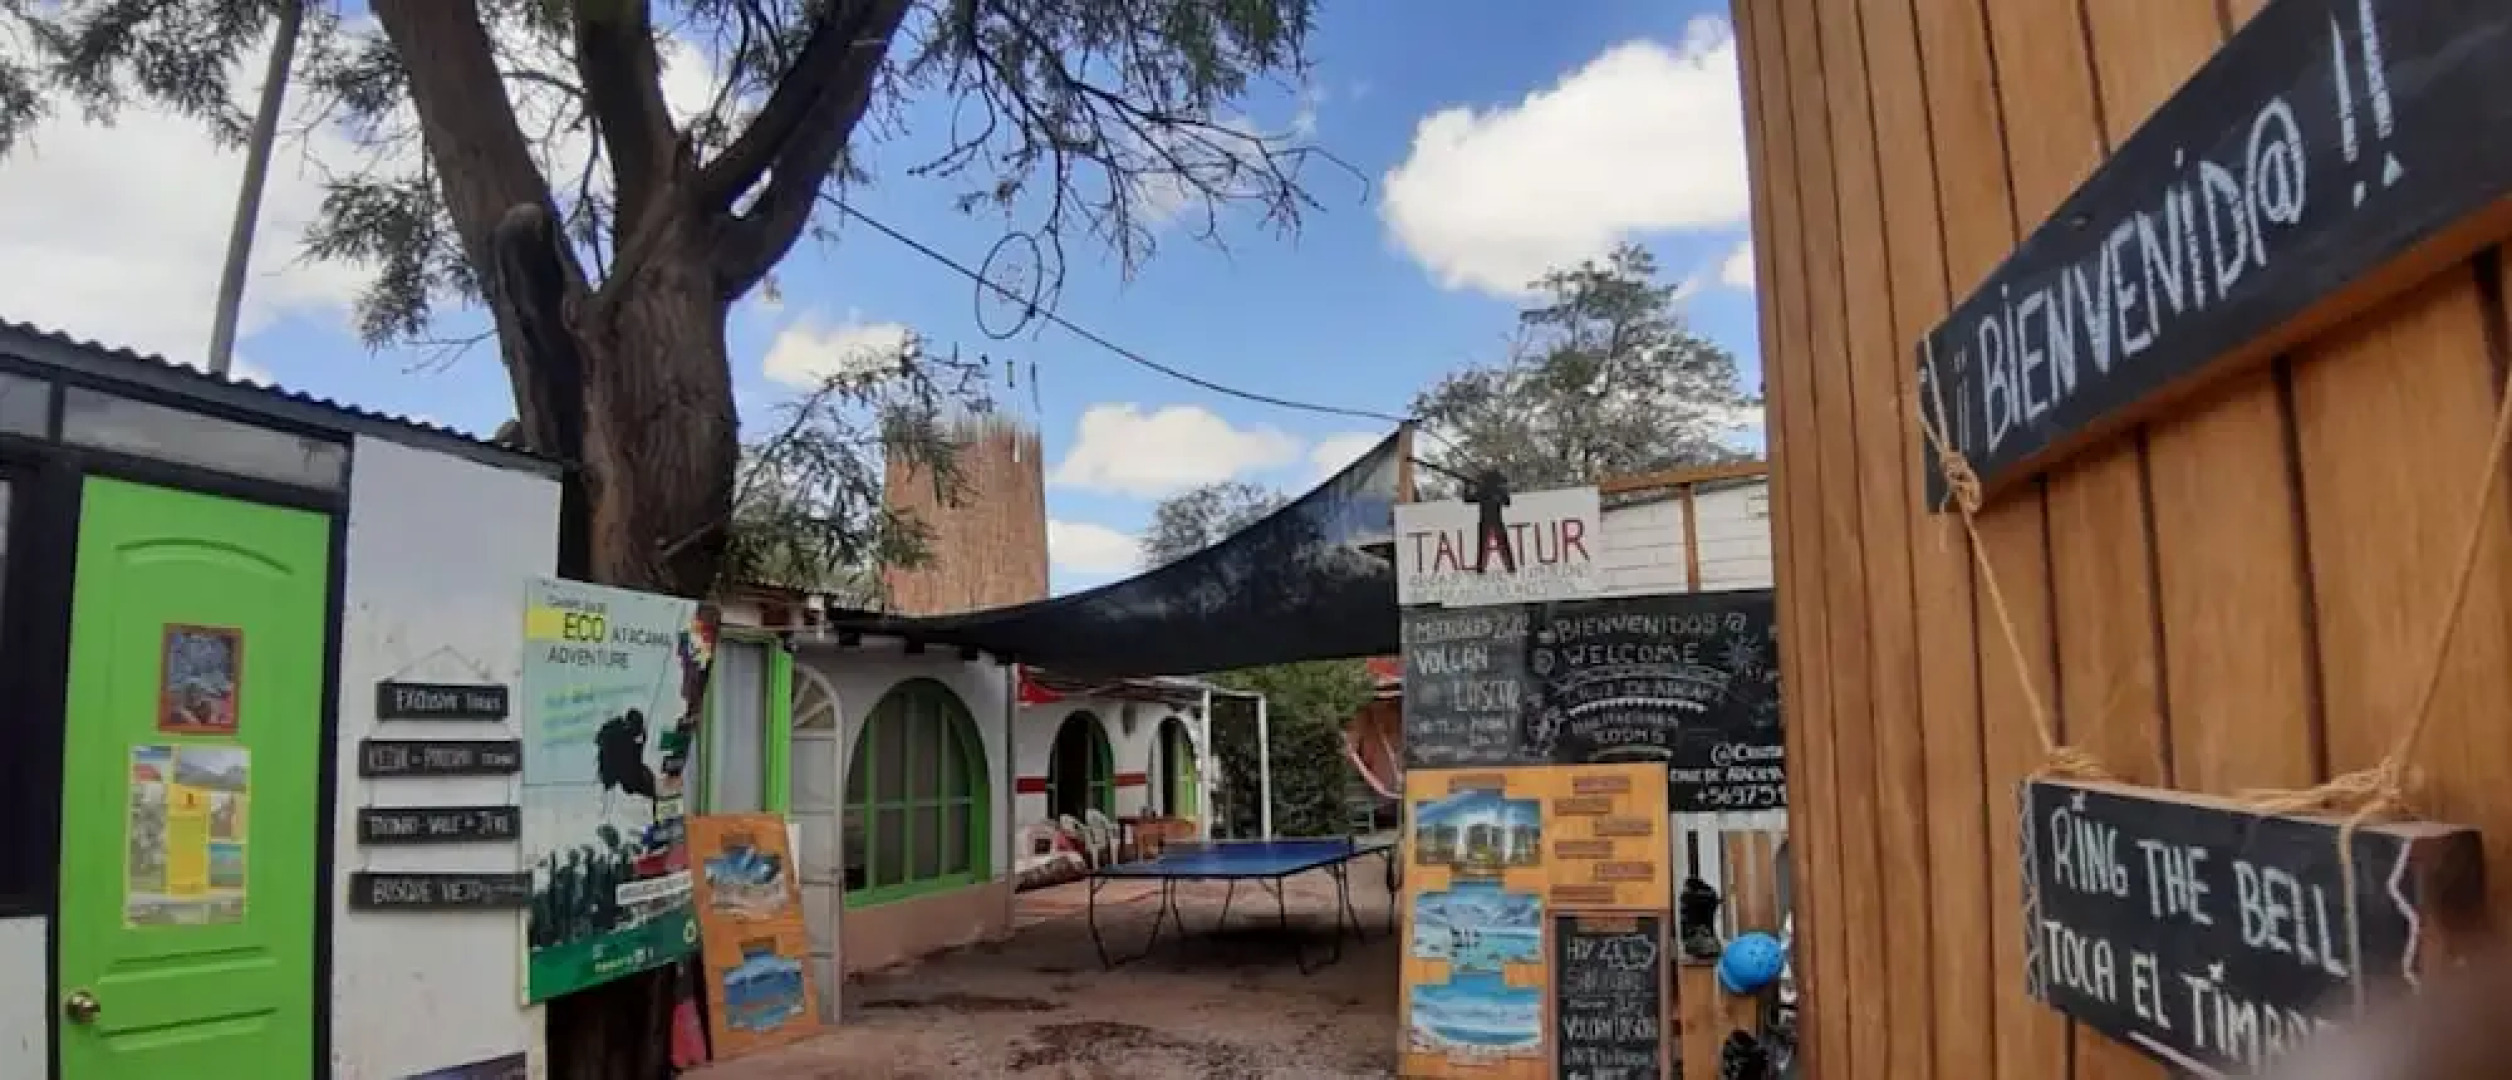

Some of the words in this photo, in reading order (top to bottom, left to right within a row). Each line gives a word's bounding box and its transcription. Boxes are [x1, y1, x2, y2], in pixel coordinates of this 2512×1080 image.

[1406, 517, 1592, 574] TALATUR
[562, 611, 606, 643] ECO
[1552, 611, 1718, 643] BIENVENIDOS
[547, 644, 630, 670] ADVENTURE
[1561, 642, 1700, 666] WELCOME
[2051, 790, 2130, 898] RING
[2136, 838, 2214, 926] THE
[2232, 859, 2350, 979] BELL
[2042, 920, 2117, 1003] TOCA
[2130, 952, 2172, 1031] EL
